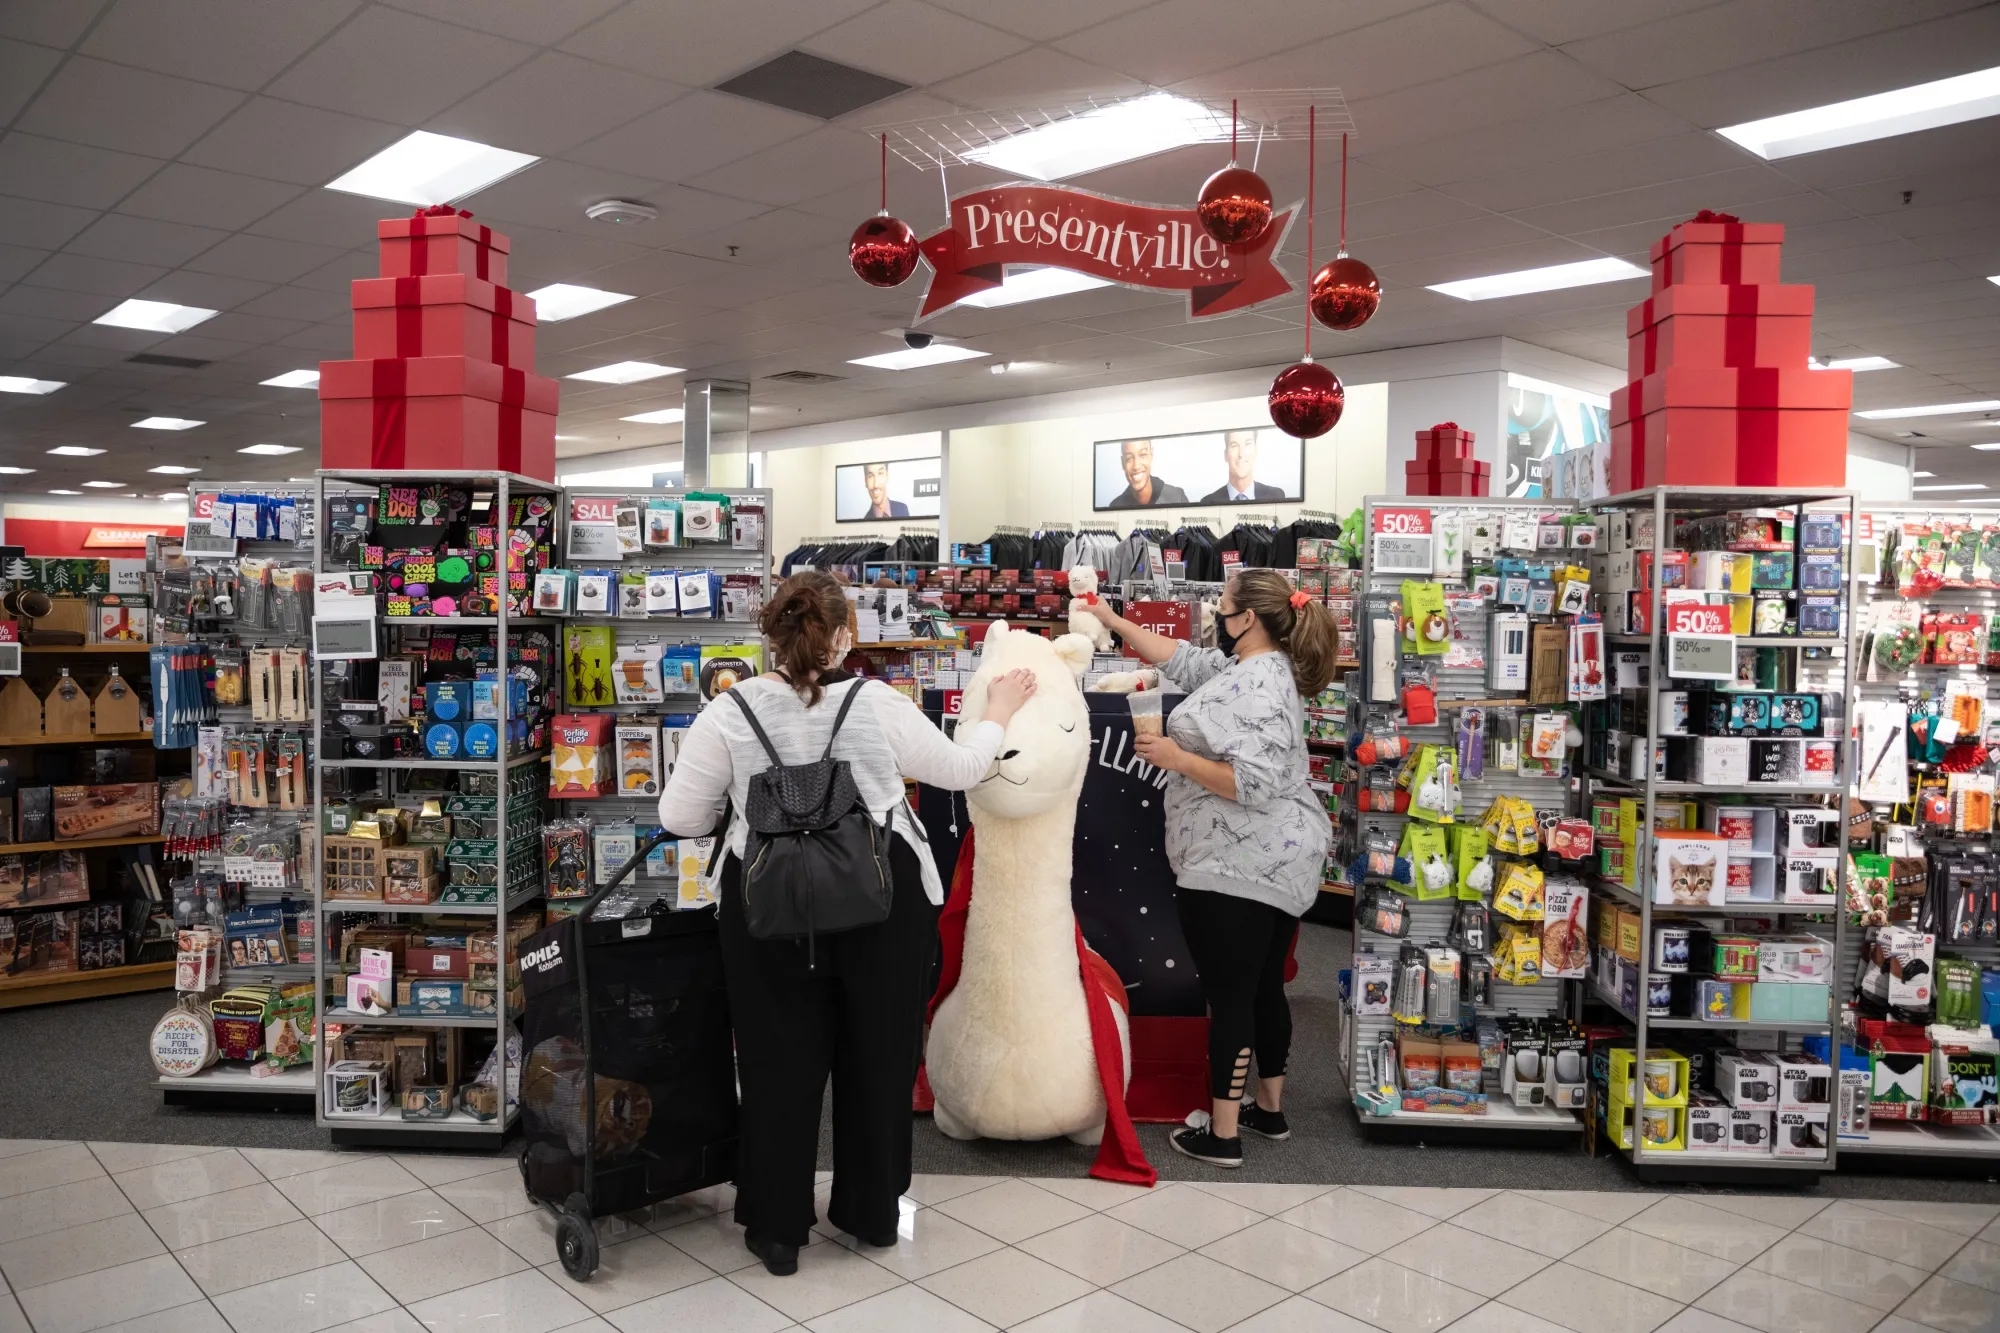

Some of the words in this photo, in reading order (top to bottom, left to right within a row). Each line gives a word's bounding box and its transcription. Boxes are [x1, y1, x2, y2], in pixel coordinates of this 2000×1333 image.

[919, 483, 938, 493] MEN
[389, 487, 419, 506] NEE
[387, 502, 417, 518] DOH
[1382, 513, 1421, 533] 50%
[190, 525, 210, 536] 50%
[573, 527, 595, 538] 50%
[364, 546, 384, 555] NEE
[1379, 541, 1400, 550] 50%
[365, 553, 384, 565] DOH
[404, 556, 435, 564] NEEDOH
[1166, 552, 1180, 562] 50%
[1223, 554, 1239, 562] SALE
[404, 564, 436, 573] COOL
[404, 573, 436, 583] CATS
[388, 601, 410, 609] COOL
[388, 608, 411, 616] CATS
[1675, 610, 1720, 633] 50%
[1705, 624, 1724, 633] OFF
[1139, 623, 1176, 636] GIFT
[1675, 641, 1700, 653] 50%
[430, 648, 453, 661] DOH
[949, 695, 962, 713] 5
[947, 720, 957, 730] 50
[563, 727, 589, 737] Tortilla
[1765, 763, 1776, 771] ON
[1548, 895, 1567, 904] PIZZA
[1548, 904, 1567, 912] FORK
[362, 957, 379, 967] WINE
[158, 1047, 199, 1055] DISASTER
[1948, 1063, 1991, 1075] DON'T
